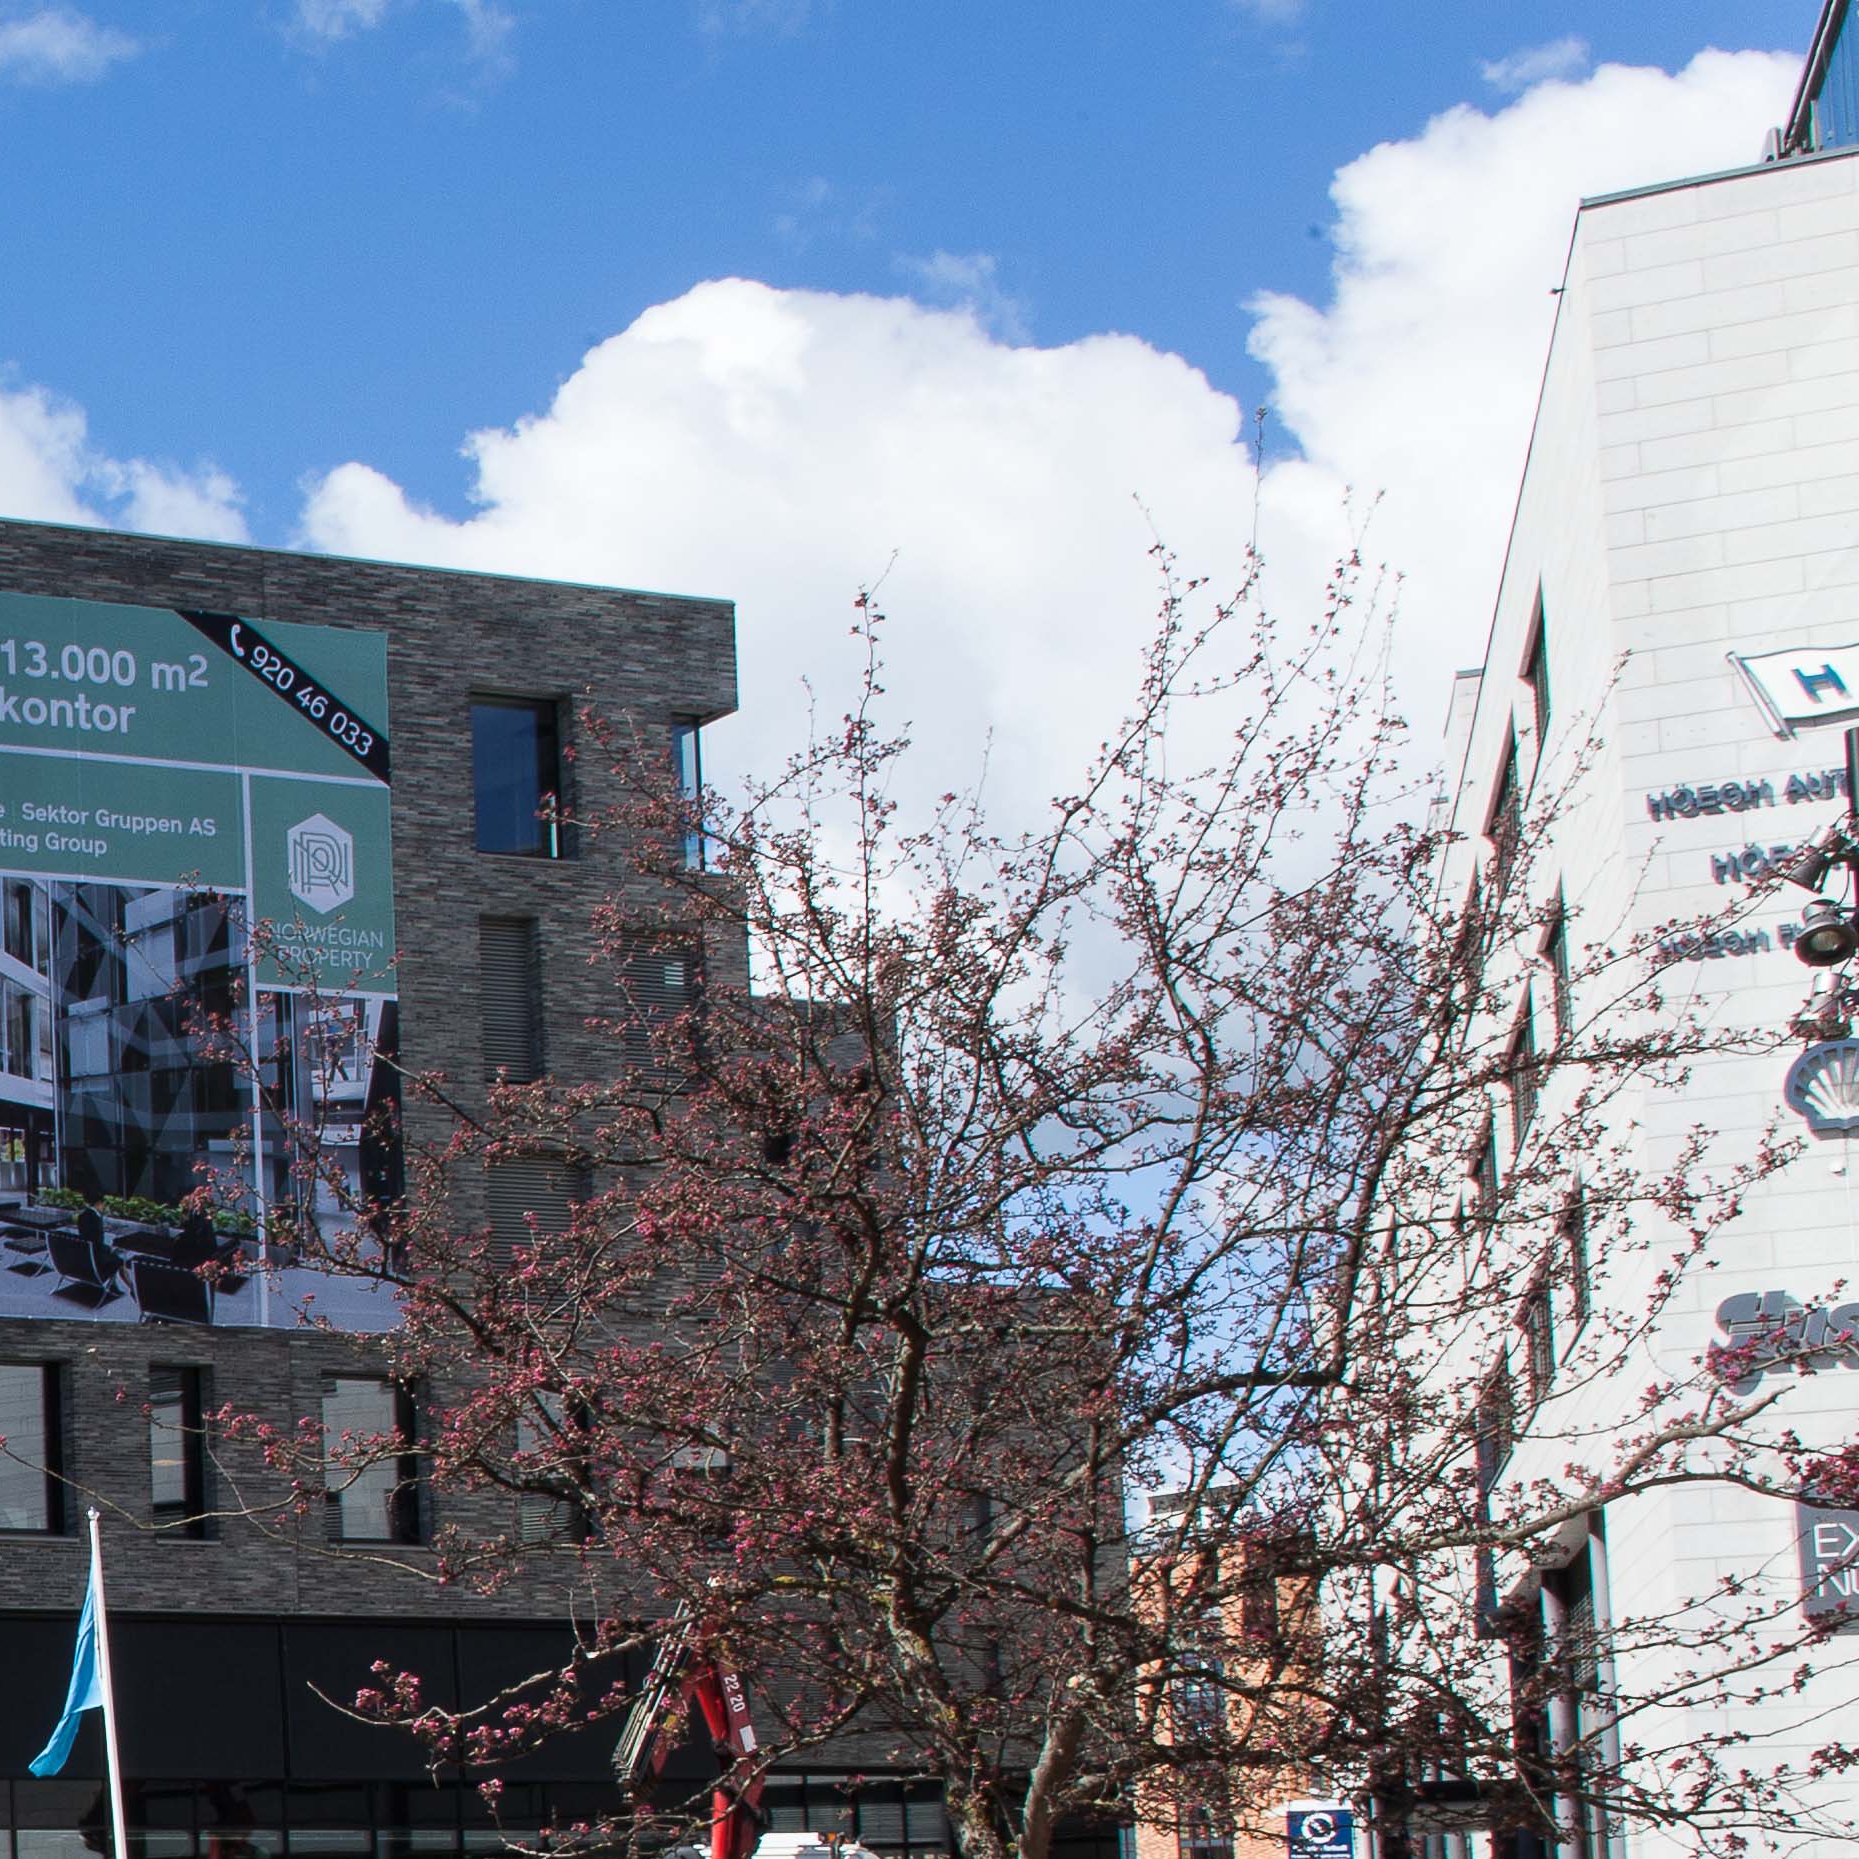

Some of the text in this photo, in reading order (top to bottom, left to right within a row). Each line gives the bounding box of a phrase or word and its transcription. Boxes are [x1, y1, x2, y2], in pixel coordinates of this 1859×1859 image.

[0, 639, 136, 686] 13.000
[250, 646, 374, 756] 920 46 033
[22, 803, 89, 825] Sektor
[95, 809, 182, 835] Gruppen
[189, 817, 216, 836] AS
[45, 832, 107, 857] Group
[724, 1674, 745, 1712] 22 20
